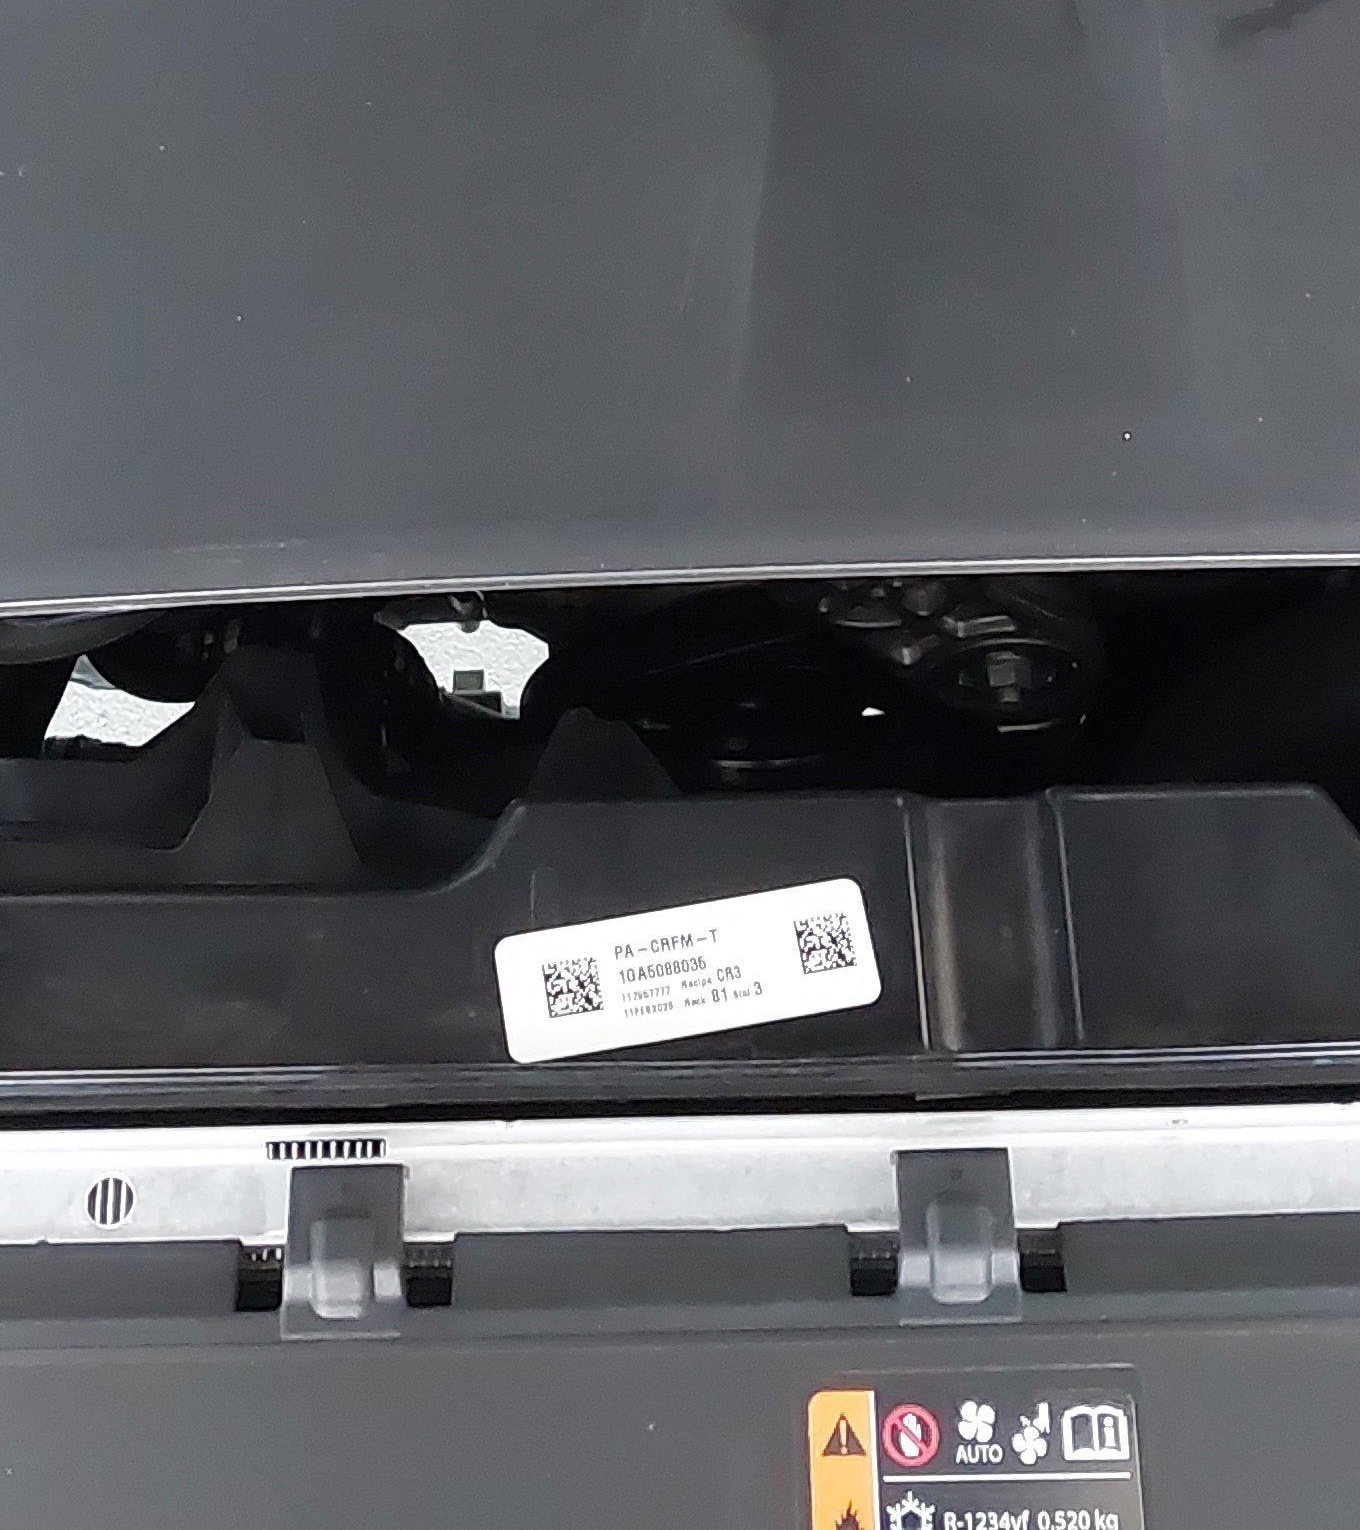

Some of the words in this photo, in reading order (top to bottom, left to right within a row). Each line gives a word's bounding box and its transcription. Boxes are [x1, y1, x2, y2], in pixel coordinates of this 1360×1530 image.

[716, 965, 742, 983] CR3
[753, 981, 763, 996] 3
[955, 1444, 1004, 1464] AUTO
